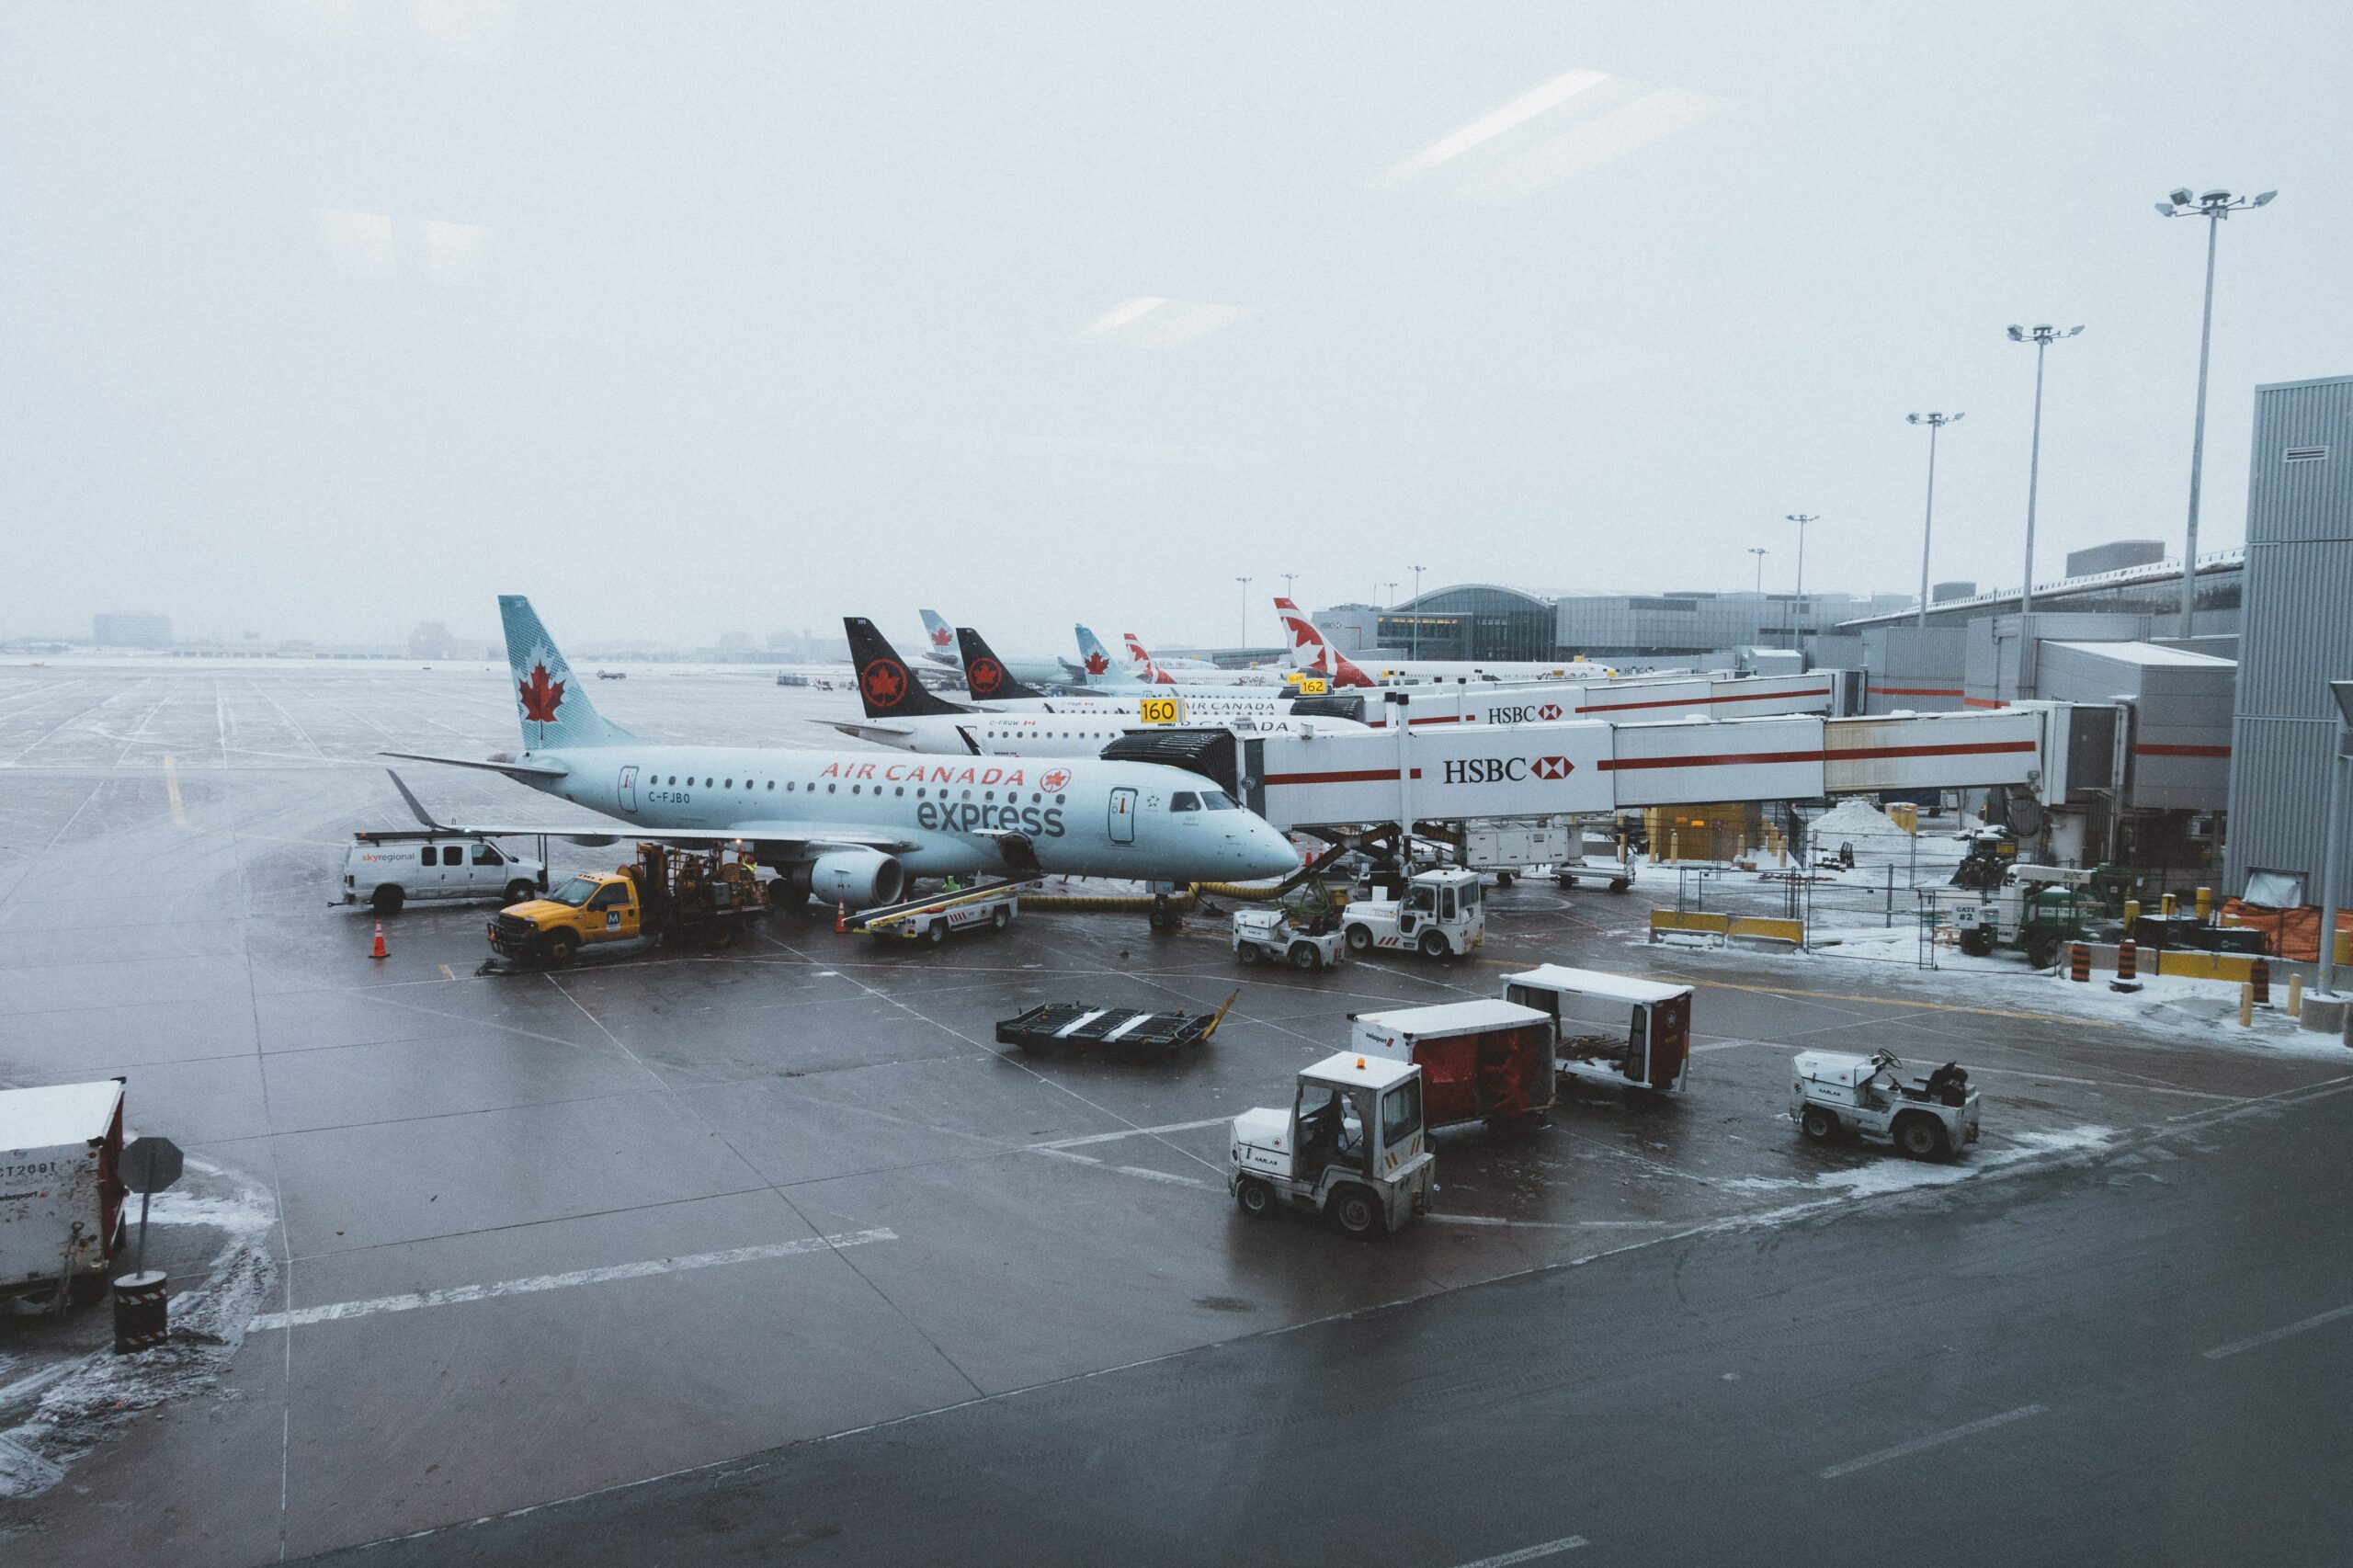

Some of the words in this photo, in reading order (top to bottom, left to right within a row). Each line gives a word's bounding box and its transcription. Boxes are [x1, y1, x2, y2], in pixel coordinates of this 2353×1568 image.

[1303, 681, 1324, 692] 162
[1142, 702, 1175, 720] 160
[1211, 702, 1275, 710] CANADA
[1488, 705, 1536, 724] HSBC
[820, 762, 877, 780] AIR
[884, 765, 1024, 786] CANADA
[1443, 757, 1527, 784] HSBC
[648, 791, 691, 804] C-FJBO
[917, 801, 1066, 838] express
[362, 852, 415, 863] skyregional
[1366, 1032, 1387, 1044] swissport
[1818, 1088, 1841, 1096] HARLAN
[1255, 1156, 1279, 1166] HARLAN
